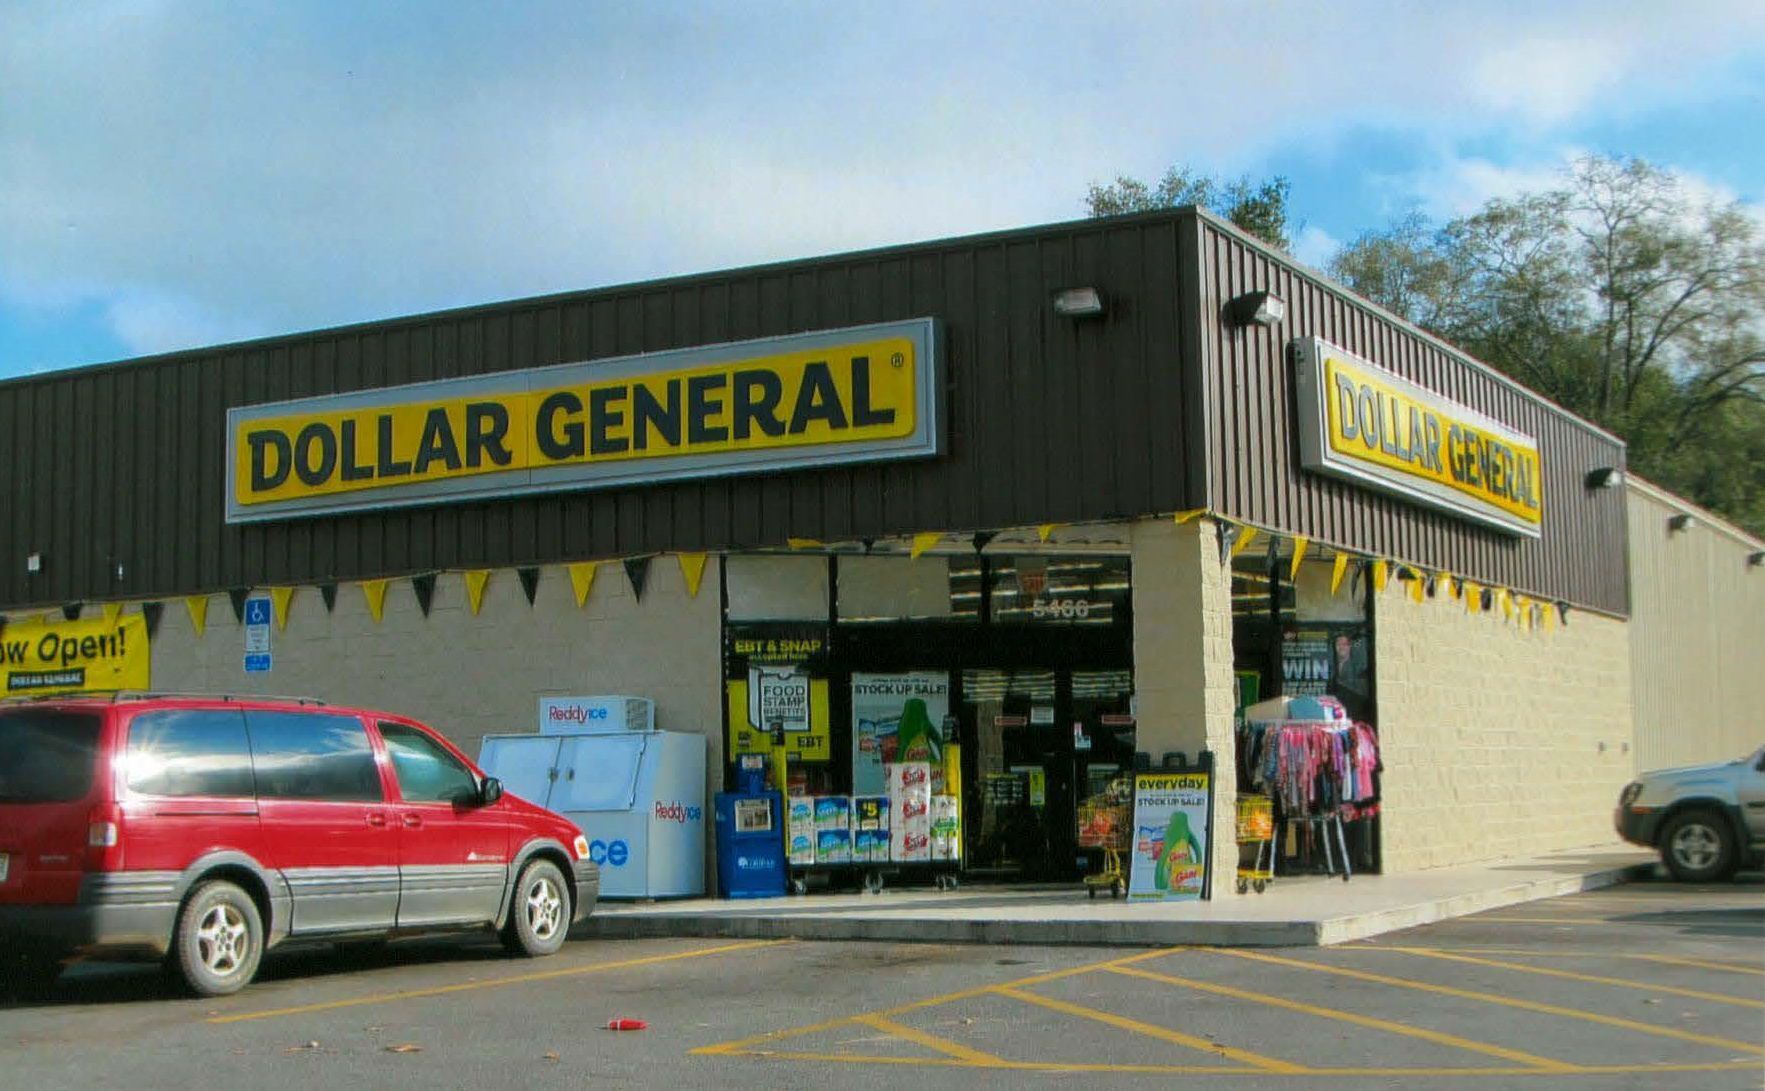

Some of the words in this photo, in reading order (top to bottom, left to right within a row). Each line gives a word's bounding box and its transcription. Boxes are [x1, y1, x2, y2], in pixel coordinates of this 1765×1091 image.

[248, 401, 512, 492] DOLLAR
[535, 356, 896, 460] GENERAL
[1335, 371, 1443, 474] DOLLAR
[1449, 423, 1538, 509] GENERAL
[1033, 599, 1089, 617] 5466
[38, 626, 126, 666] Open!
[1282, 659, 1329, 680] WIN
[763, 685, 805, 697] FOOD
[763, 697, 805, 708] STAMP
[1138, 776, 1204, 790] everyday
